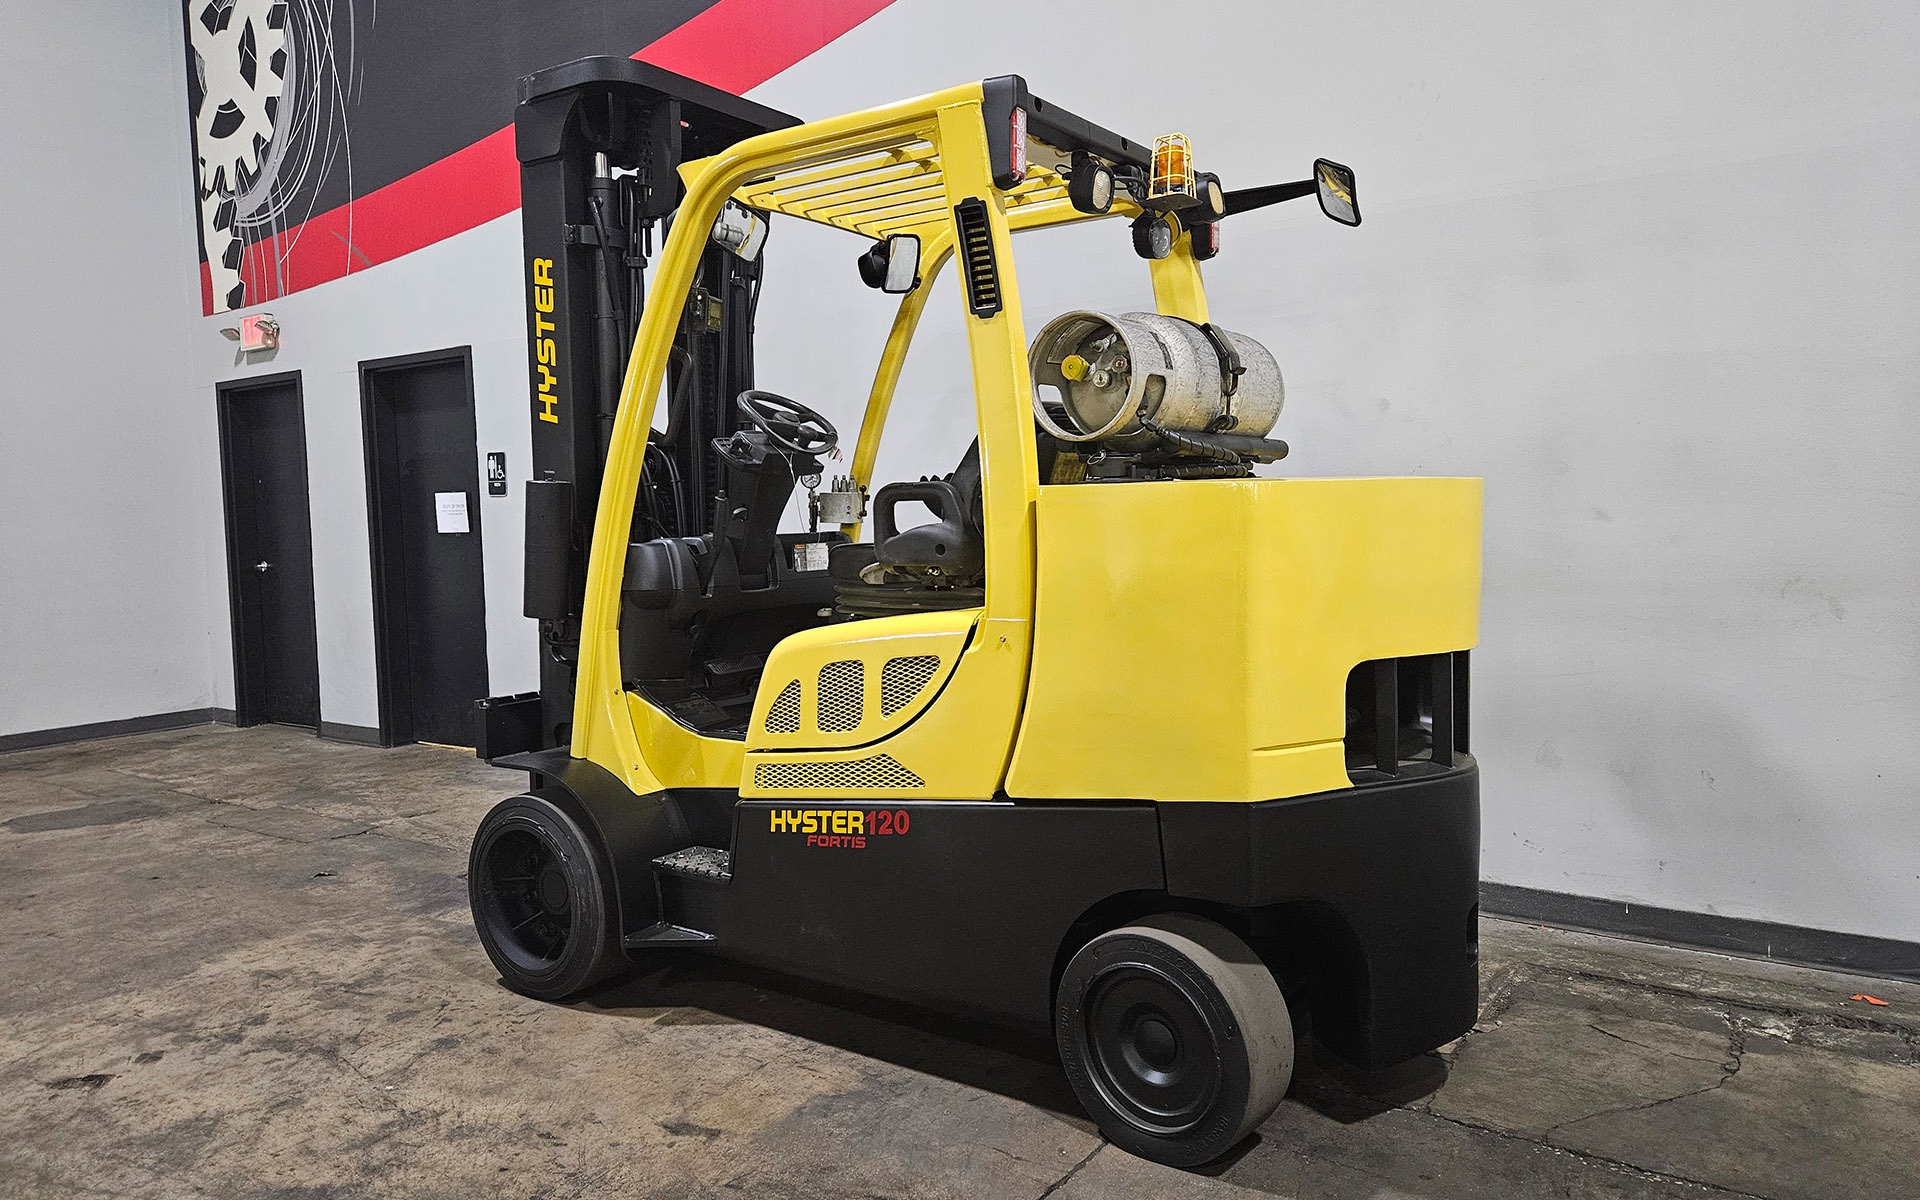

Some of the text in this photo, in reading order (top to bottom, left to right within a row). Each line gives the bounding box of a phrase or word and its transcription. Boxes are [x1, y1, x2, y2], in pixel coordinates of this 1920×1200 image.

[533, 257, 559, 424] HYSTER
[770, 809, 910, 835] HYSTER 120
[806, 834, 866, 849] FORTIS
